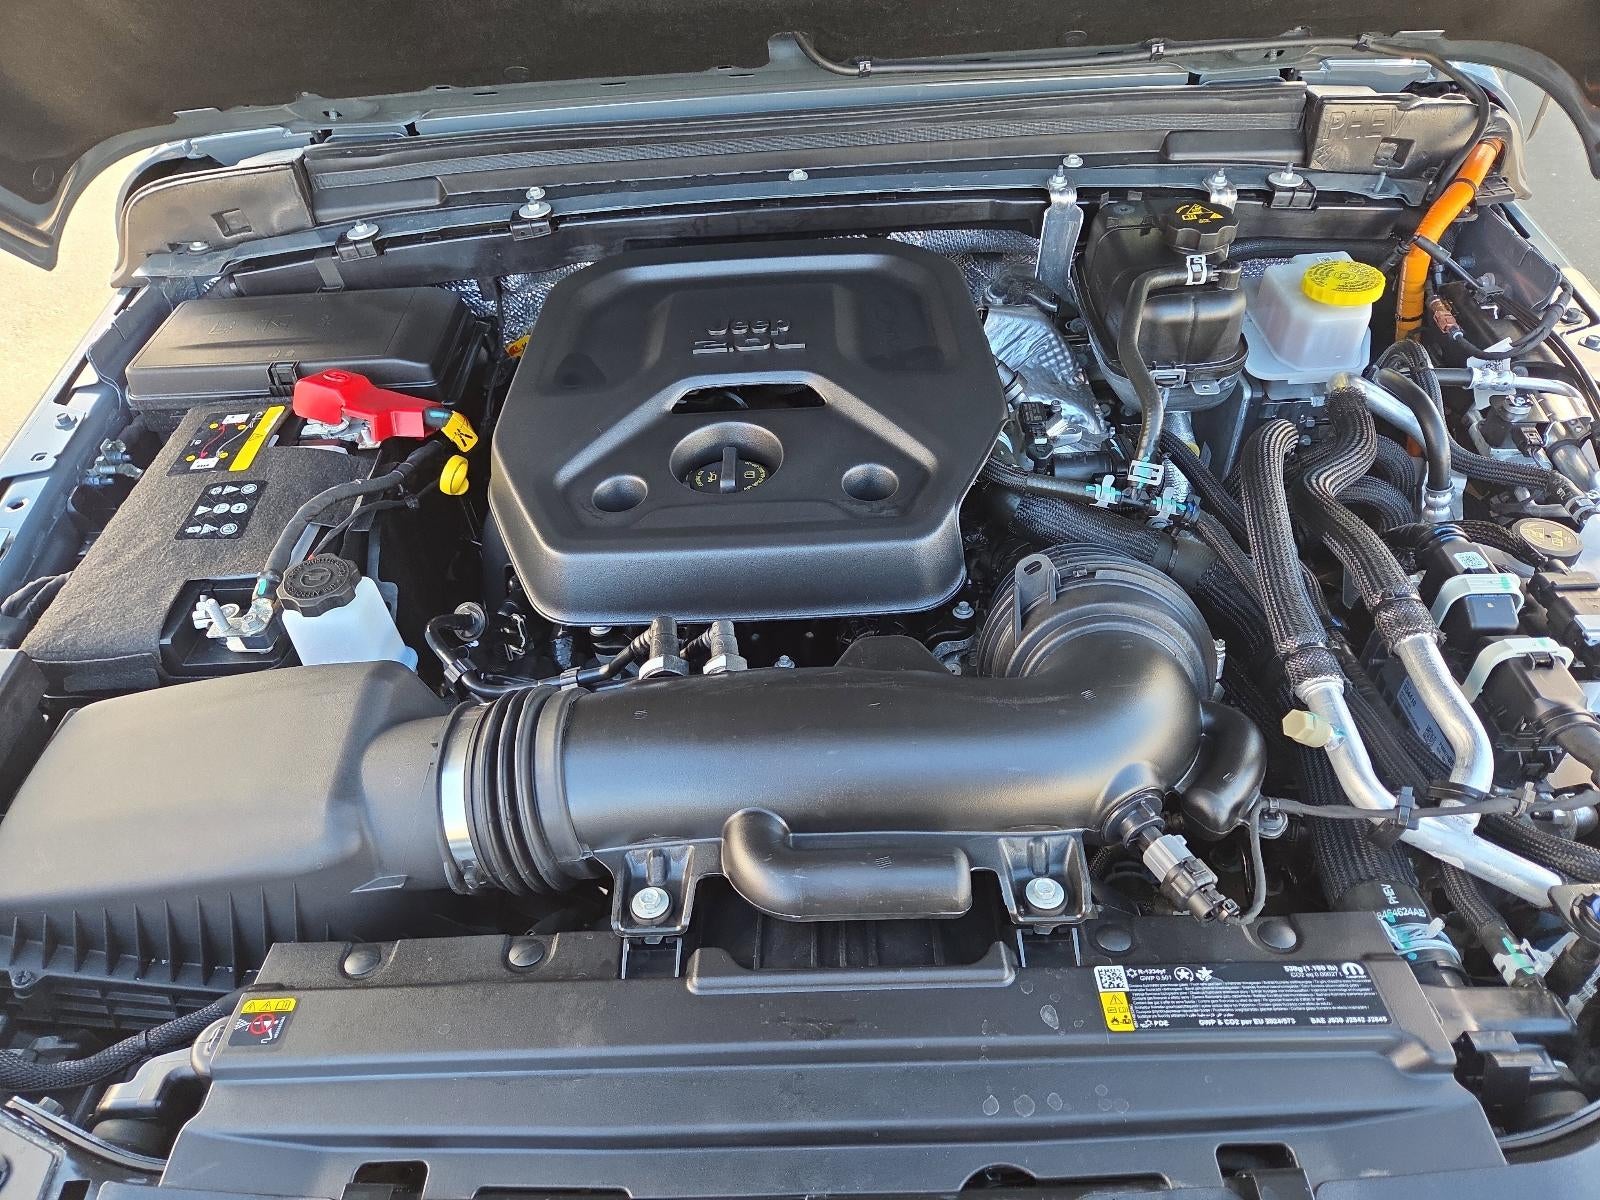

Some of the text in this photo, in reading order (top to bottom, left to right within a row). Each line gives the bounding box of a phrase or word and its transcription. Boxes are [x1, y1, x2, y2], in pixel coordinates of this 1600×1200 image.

[1322, 109, 1409, 141] PHEV
[708, 317, 790, 336] Jeep
[692, 338, 806, 355] 2.0L
[1381, 884, 1399, 904] PHEV
